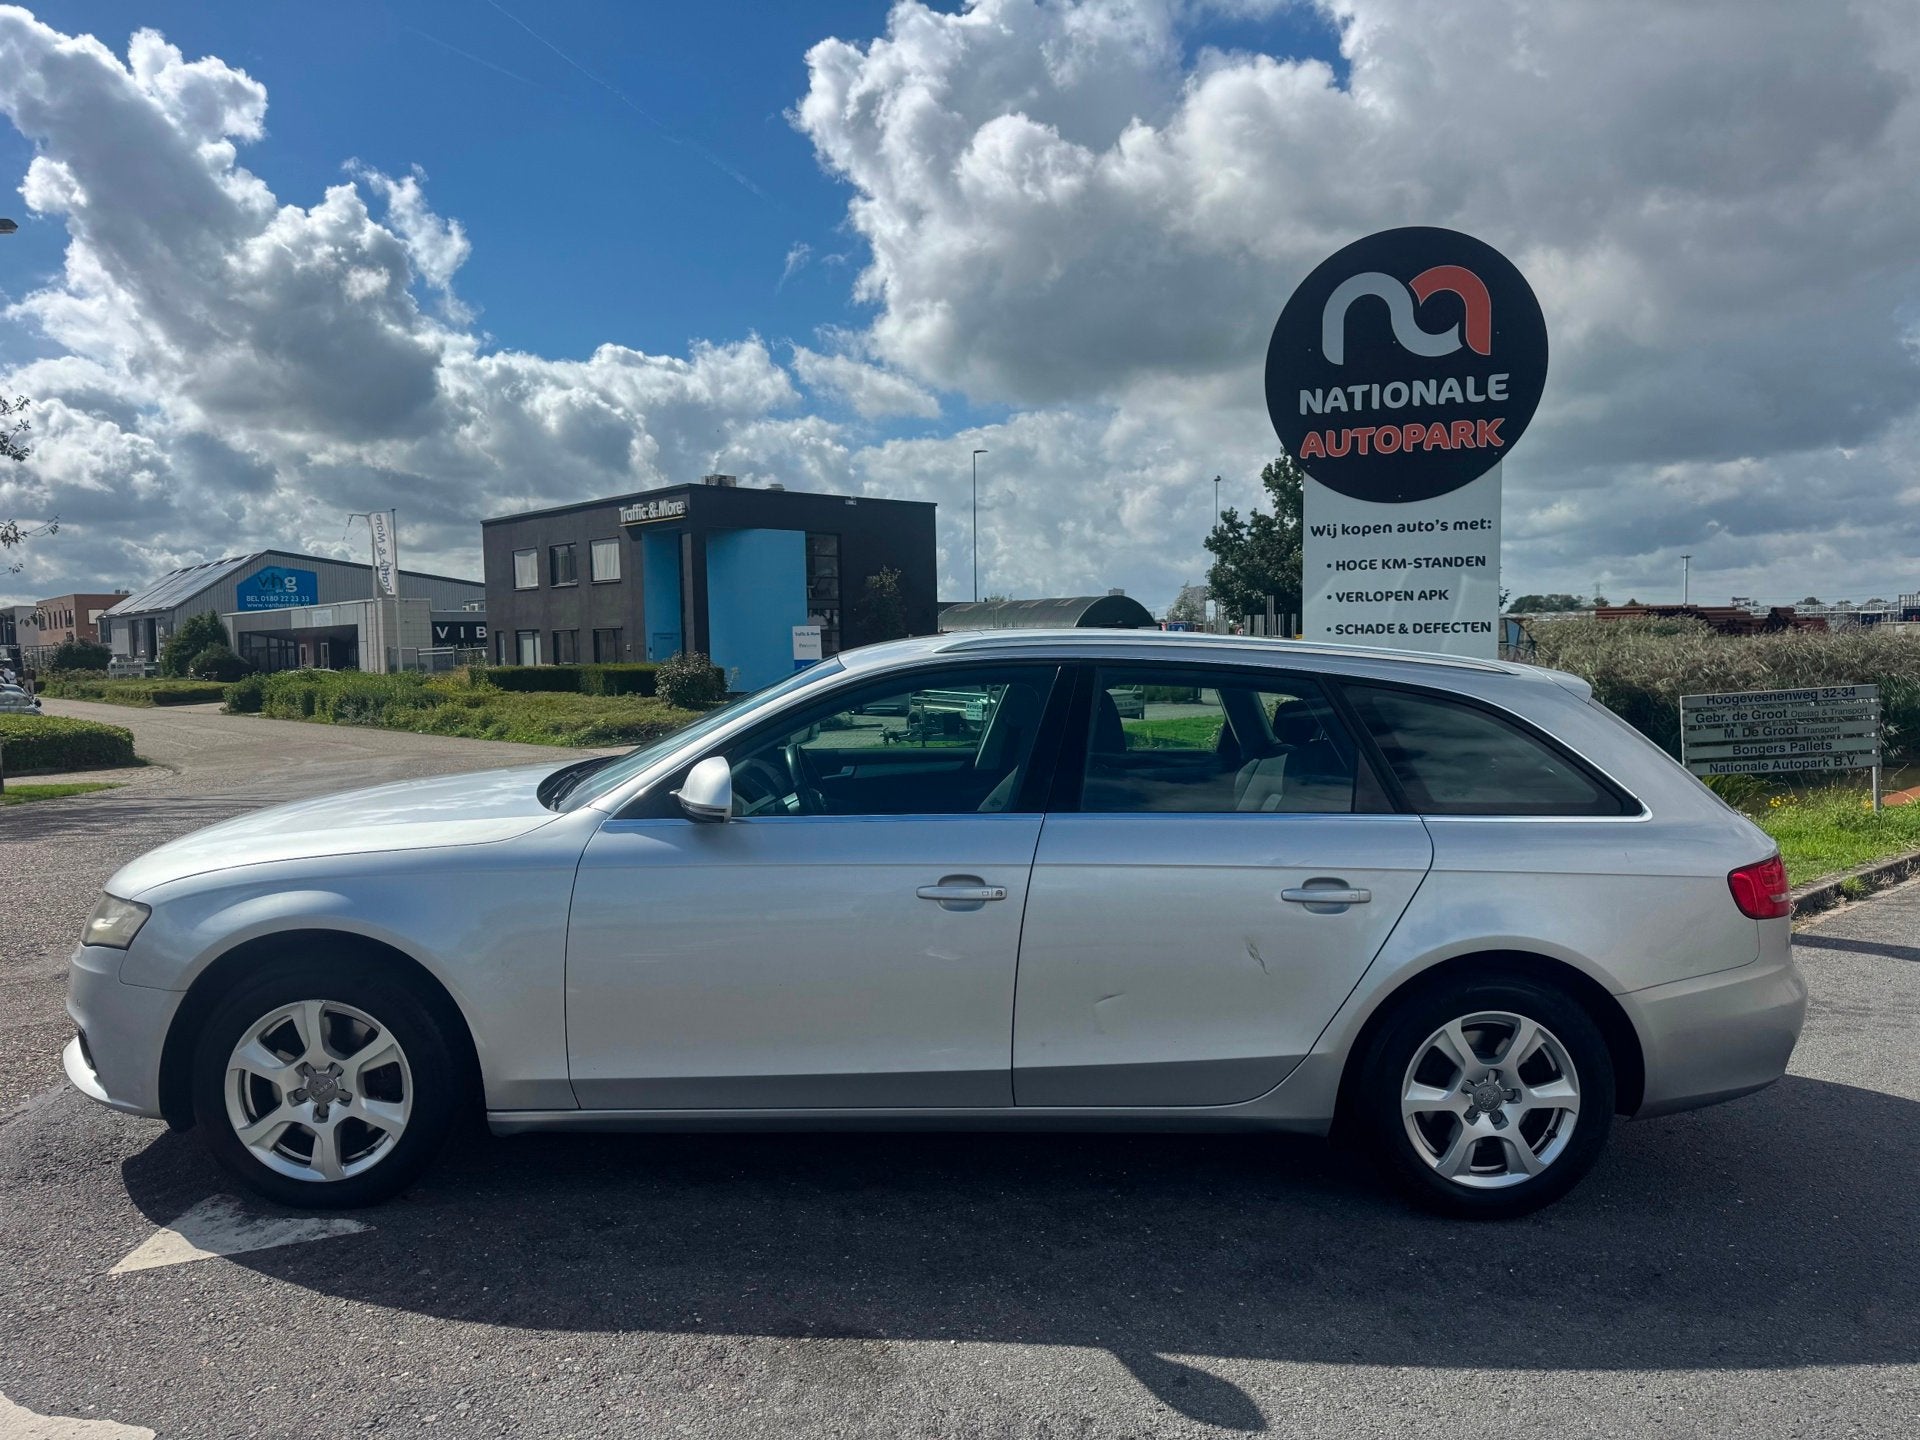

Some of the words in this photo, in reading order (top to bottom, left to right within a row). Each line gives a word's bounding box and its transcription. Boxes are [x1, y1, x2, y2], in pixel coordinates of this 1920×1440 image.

[1299, 373, 1510, 415] NATIONALE
[1299, 417, 1506, 459] AUTOPARK
[619, 503, 648, 523] Traffic
[648, 502, 658, 518] &
[659, 500, 686, 517] More
[1310, 523, 1337, 539] Wij
[1341, 523, 1392, 537] kopen
[1396, 519, 1449, 533] auto’s
[1453, 517, 1492, 531] met:
[1335, 559, 1378, 571] HOGE
[1381, 555, 1486, 570] KM-STANDEN
[1335, 590, 1414, 603] VERLOPEN
[1417, 589, 1449, 601] APK
[1335, 622, 1395, 635] SCHADE
[1398, 622, 1409, 634] &
[1412, 621, 1492, 634] DEFECTEN
[1706, 689, 1818, 705] Hoogeveenenweg
[1822, 687, 1856, 698] 32-34
[1695, 713, 1728, 724] Gebr.
[1732, 710, 1748, 721] de
[1751, 709, 1787, 720] Groot
[1790, 709, 1819, 719] Opslag
[1821, 709, 1828, 717] &
[1830, 706, 1868, 717] Transport
[1724, 728, 1738, 739] M.
[1742, 727, 1759, 737] De
[1762, 725, 1799, 736] Groot
[1802, 725, 1840, 736] Transport
[1733, 743, 1785, 756] Bongers
[1790, 740, 1833, 752] Pallets
[1709, 762, 1769, 774] Nationale
[1772, 757, 1830, 772] Autopark
[1834, 756, 1858, 767] B.V.
